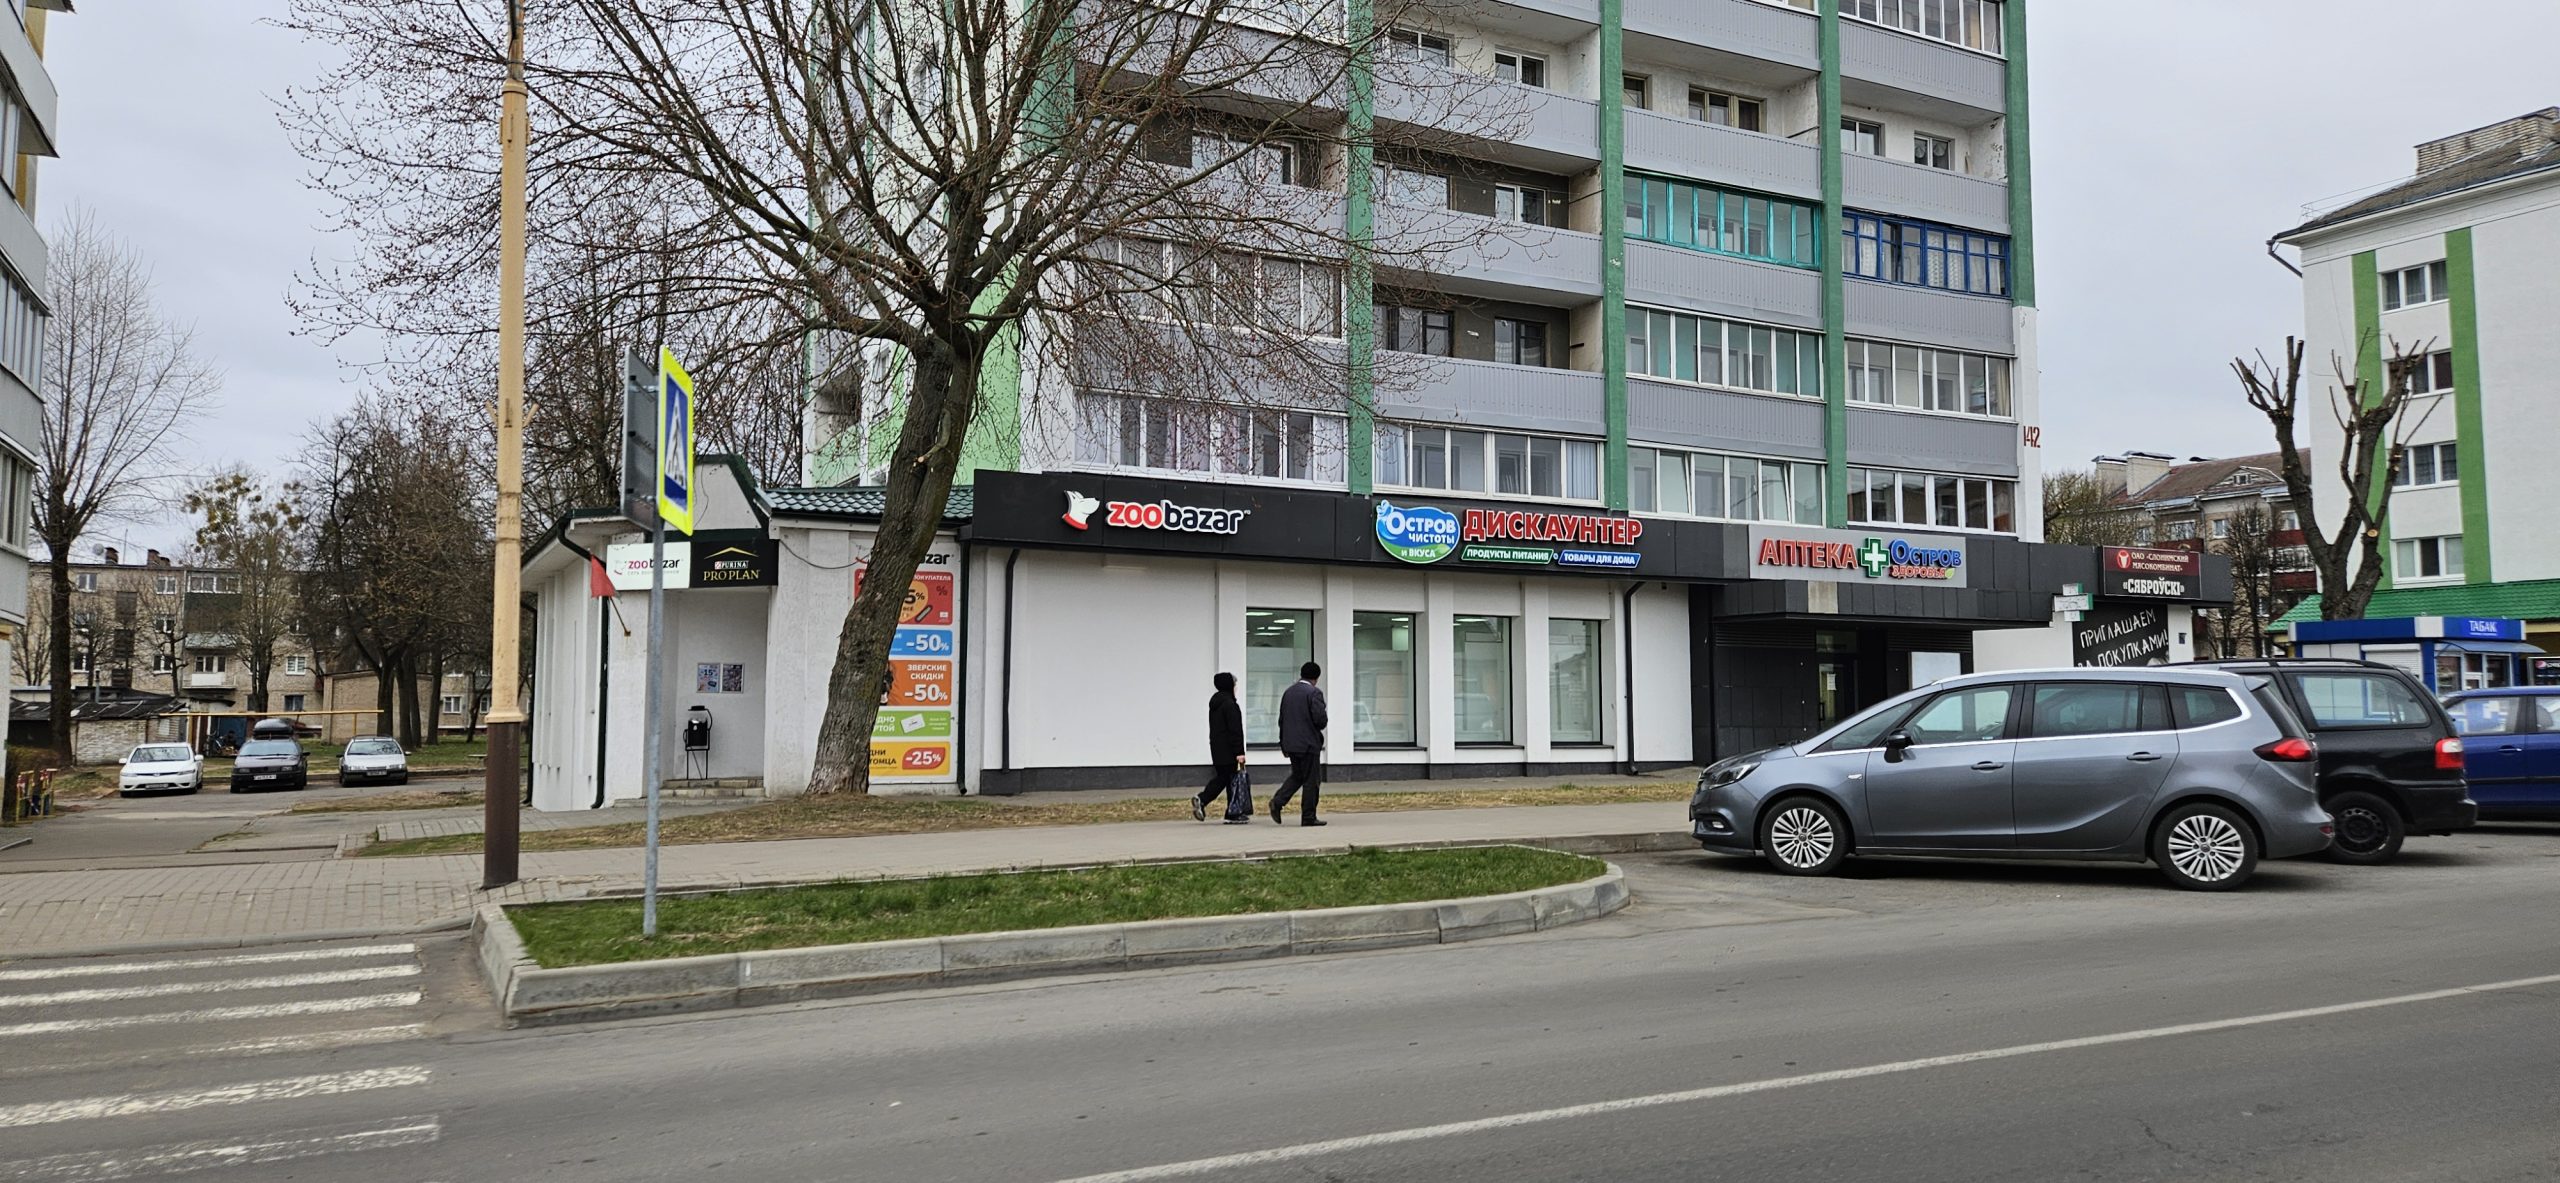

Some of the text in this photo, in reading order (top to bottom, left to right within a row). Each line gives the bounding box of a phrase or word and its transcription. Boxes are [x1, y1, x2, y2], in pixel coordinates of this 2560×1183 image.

[2023, 425, 2041, 448] 142
[1106, 499, 1243, 535] zoobazar
[1386, 511, 1457, 535] ОСТРОВ
[1463, 509, 1643, 545] ДИСКАУНТЕР
[1408, 532, 1455, 545] ЧИСТОТЫ
[1408, 548, 1436, 558] ВКУСА
[1466, 549, 1549, 561] ПРОДУКТЫ ПИТАНИЯ
[1564, 553, 1635, 566] ТОВАРЫ ДЛЯ ДОМА
[1759, 538, 1859, 569] АПТЕКА
[1890, 538, 1962, 568] ОСТРОВ
[2131, 552, 2145, 560] ОАО
[720, 560, 748, 569] PURINA
[1891, 565, 1947, 579] ЗДОРОВЬЯ
[703, 569, 760, 580] PRO PLAN
[2080, 608, 2157, 649] ПРИГЛАШАЕМ
[2468, 620, 2497, 633] ТАБАК
[906, 634, 950, 651] -50%
[2097, 628, 2169, 667] ПОКУПКАМИ!
[910, 672, 945, 680] СКИДКИ
[904, 683, 948, 701] -50%
[905, 751, 942, 766] -25%
